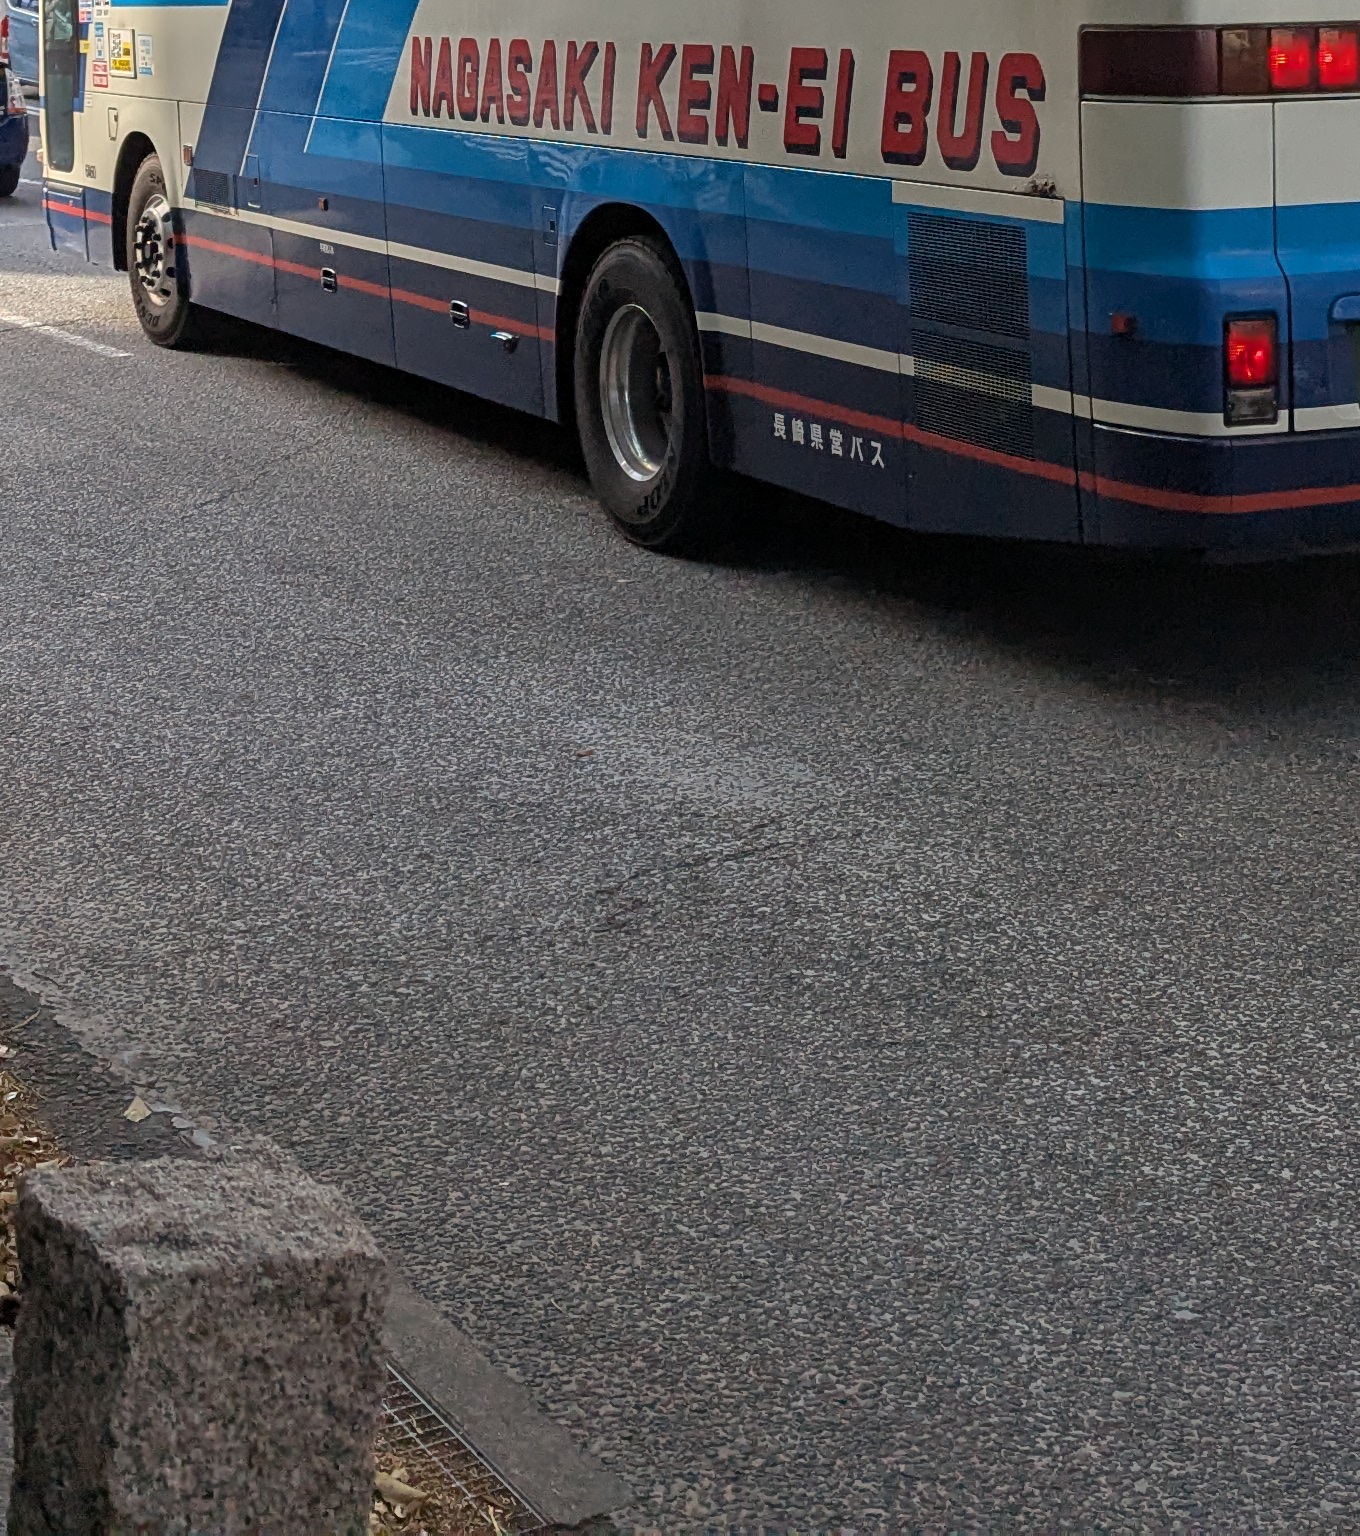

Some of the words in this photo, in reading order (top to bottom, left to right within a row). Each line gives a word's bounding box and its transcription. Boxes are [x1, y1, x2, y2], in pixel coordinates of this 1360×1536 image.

[409, 35, 617, 136] NAGASAKI
[635, 41, 855, 160] KEN-EI
[880, 49, 1047, 178] BUS
[773, 413, 885, 469] 長崎県営バス
